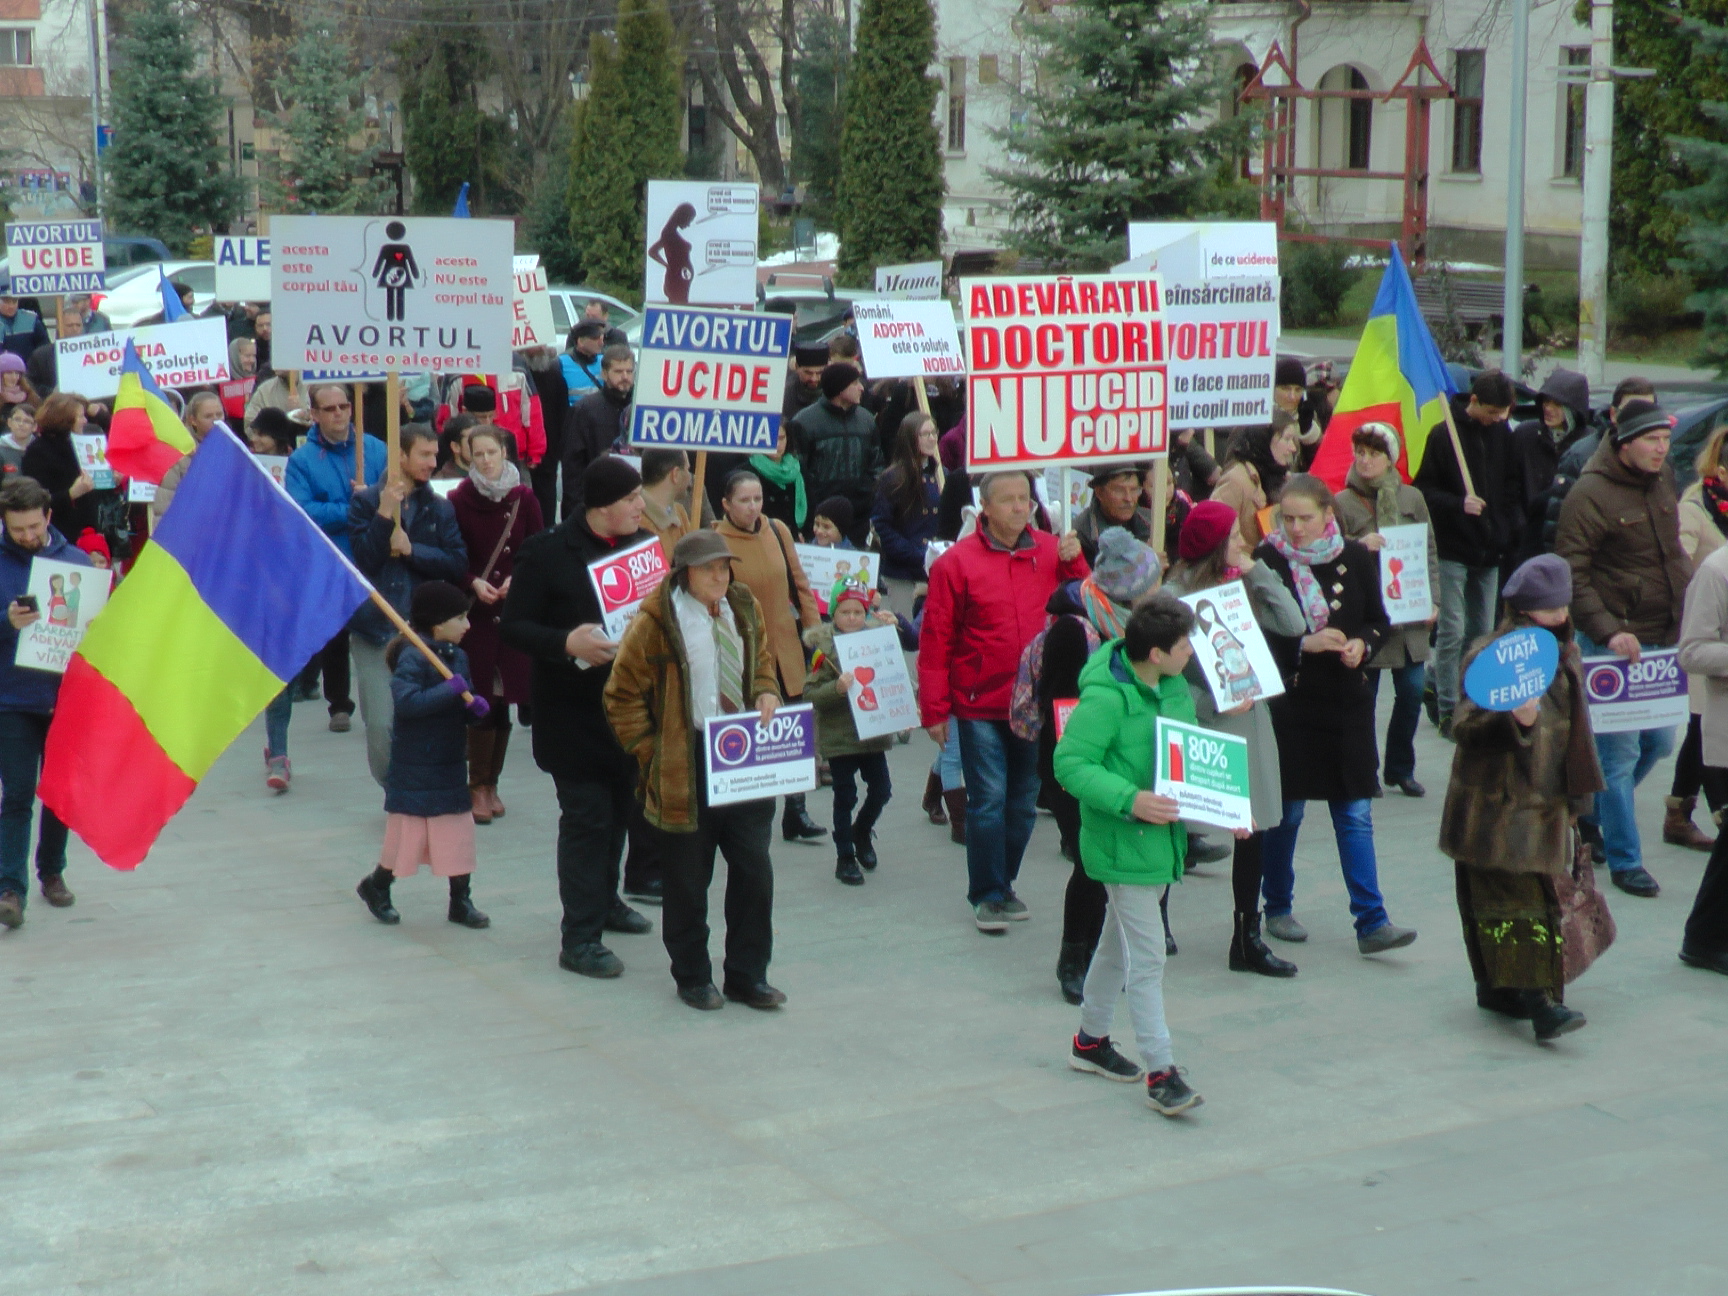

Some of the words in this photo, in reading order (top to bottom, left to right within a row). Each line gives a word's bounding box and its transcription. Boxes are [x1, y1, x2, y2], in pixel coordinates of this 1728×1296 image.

[12, 224, 98, 244] AVORTUL
[22, 247, 94, 270] UCIDE
[218, 238, 271, 266] ALE
[282, 245, 329, 255] acesta
[1211, 253, 1223, 265] de
[1225, 255, 1236, 265] ce
[1237, 253, 1277, 265] uciderea
[282, 263, 314, 273] este
[435, 257, 478, 267] acesta
[282, 280, 330, 293] corpul
[435, 273, 456, 284] NU
[459, 275, 488, 286] este
[513, 273, 545, 294] UL
[435, 292, 478, 306] corpul
[854, 304, 894, 320] Români,
[306, 324, 482, 349] AVORTUL
[650, 312, 782, 353] AVORTUL
[892, 341, 912, 354] este
[913, 342, 919, 353] o
[971, 319, 1164, 371] DOCTORI
[305, 350, 333, 363] NU
[339, 351, 379, 364] este
[385, 354, 396, 365] o
[401, 351, 482, 370] alegere!
[154, 362, 229, 386] NOBILĂ
[662, 359, 771, 403] UCIDE
[1174, 375, 1189, 392] te
[1192, 374, 1223, 391] face
[1226, 373, 1270, 390] mama
[973, 375, 1066, 459] NU
[1071, 371, 1164, 411] UCID
[1192, 399, 1229, 421] copil
[1231, 399, 1269, 417] mort.
[641, 409, 772, 447] ROMÂNIA
[1071, 409, 1163, 454] COPII
[628, 547, 662, 579] 80%
[1627, 656, 1678, 683] 80%
[1490, 673, 1546, 706] FEMEIE
[754, 714, 804, 744] 80%
[1188, 735, 1228, 769] 80%
